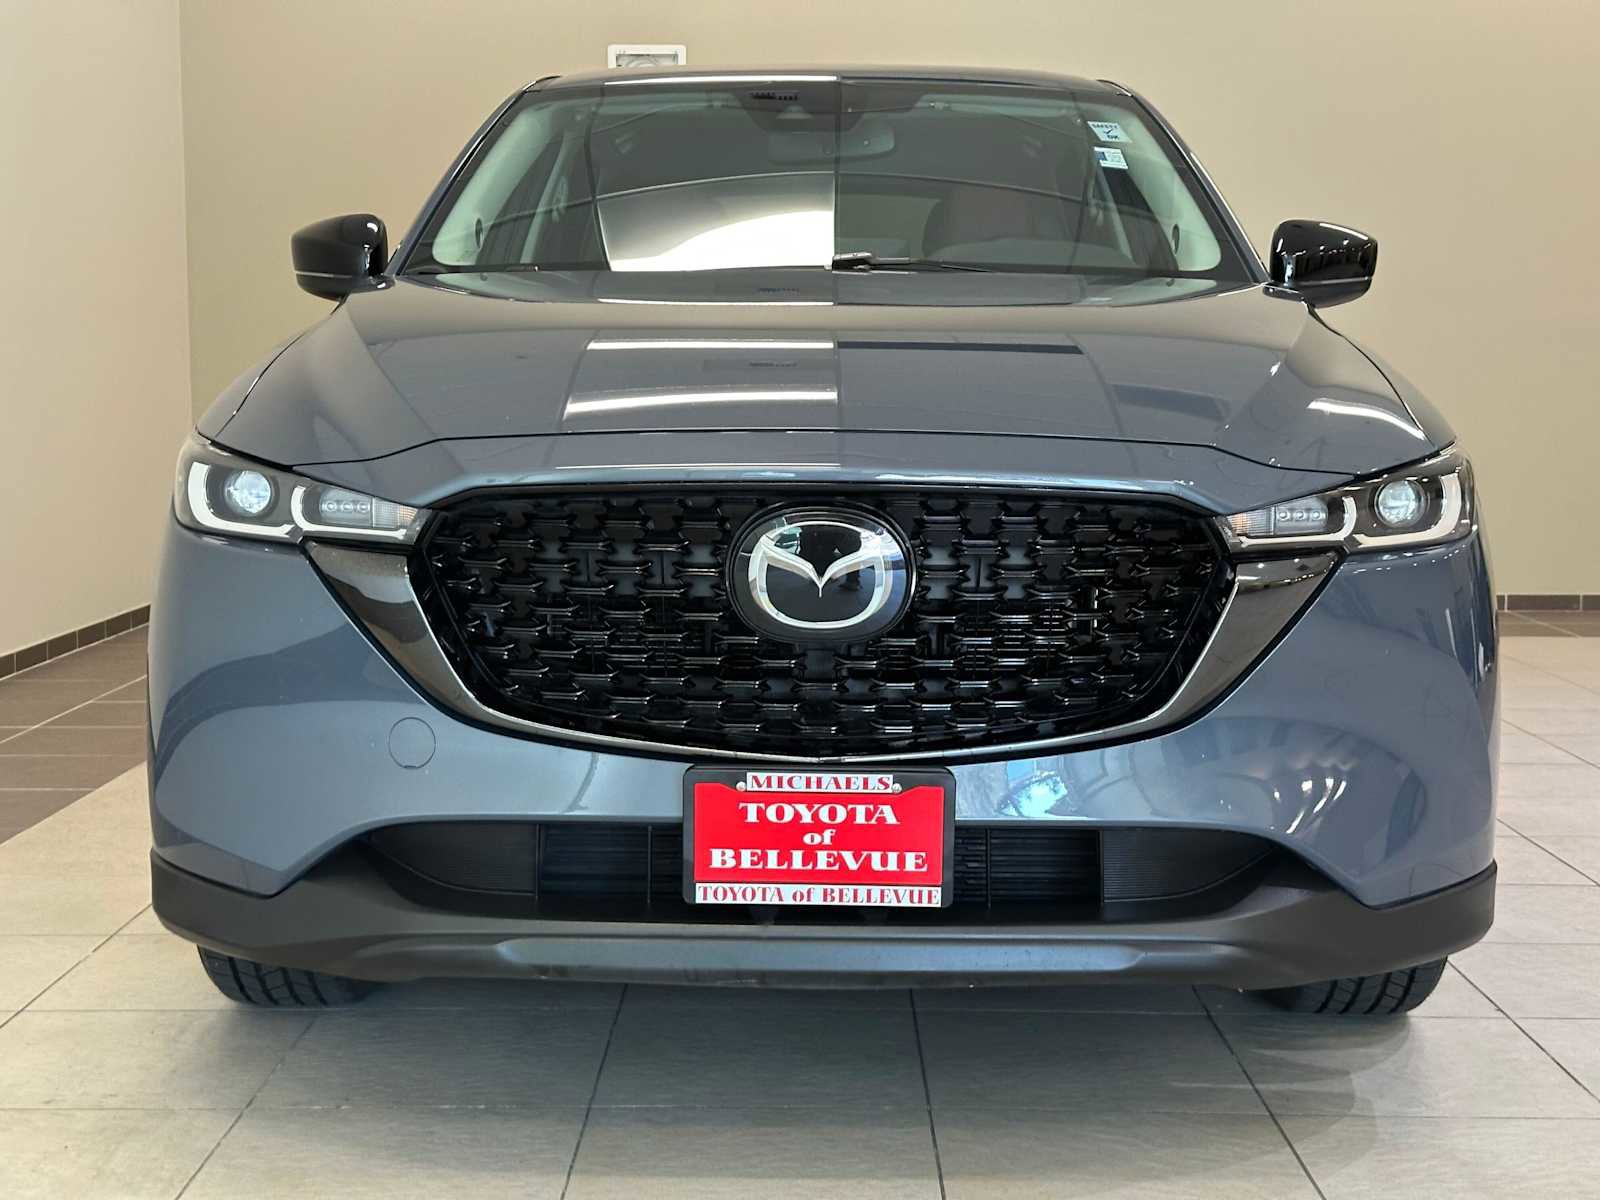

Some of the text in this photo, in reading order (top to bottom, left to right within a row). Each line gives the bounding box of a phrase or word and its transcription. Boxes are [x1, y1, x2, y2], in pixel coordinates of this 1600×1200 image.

[751, 775, 891, 791] MICHAELS
[738, 803, 900, 825] TOYOTA
[803, 829, 835, 845] of
[709, 848, 928, 871] BELLEVUE
[698, 885, 939, 905] TOYOTA of BELLEVUE
